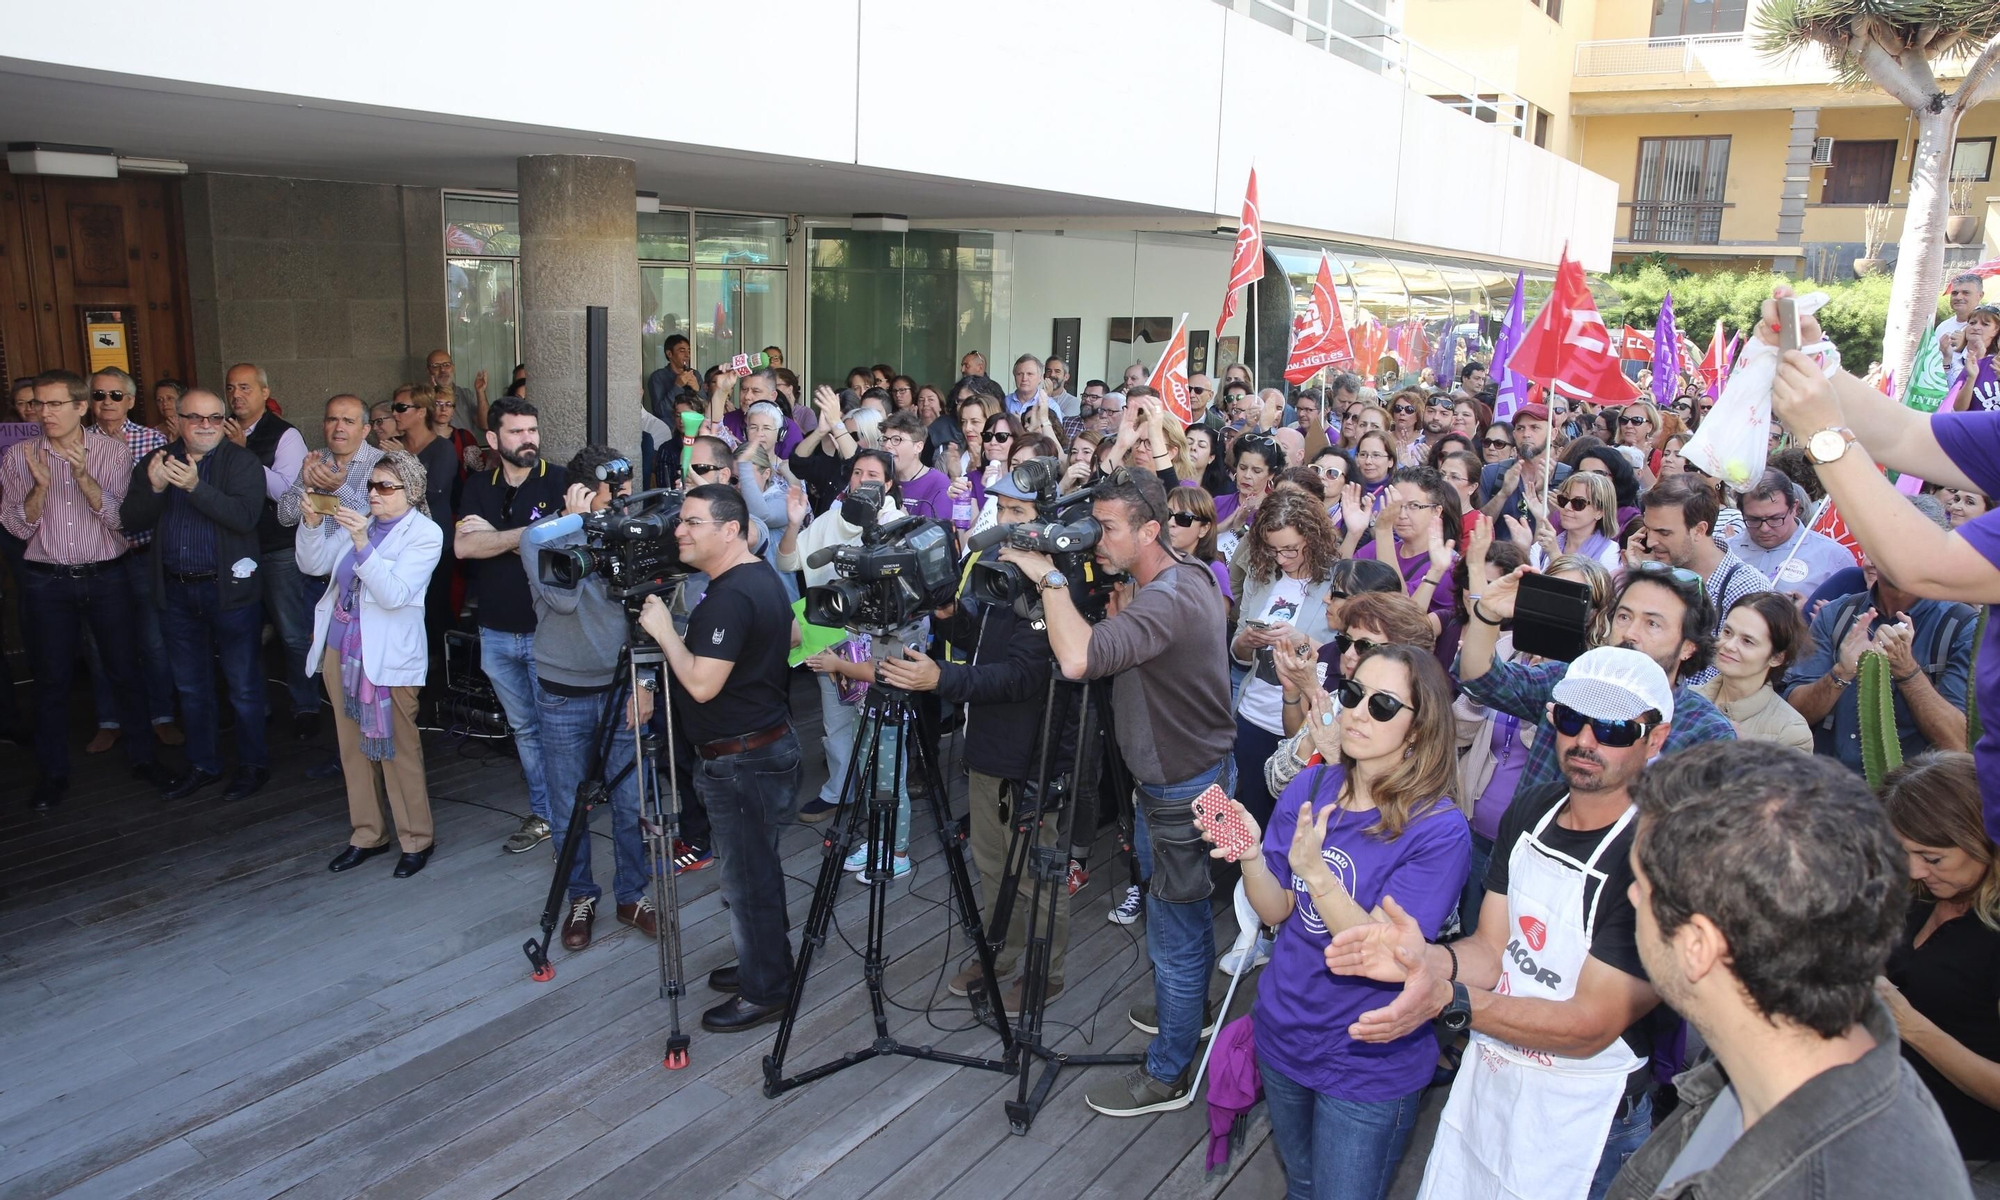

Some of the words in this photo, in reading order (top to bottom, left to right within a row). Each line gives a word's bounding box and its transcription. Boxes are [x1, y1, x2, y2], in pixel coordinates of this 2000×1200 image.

[1911, 393, 1943, 408] INTE
[629, 525, 643, 535] tve
[1322, 850, 1348, 869] MARZO
[1506, 939, 1562, 991] ACOR
